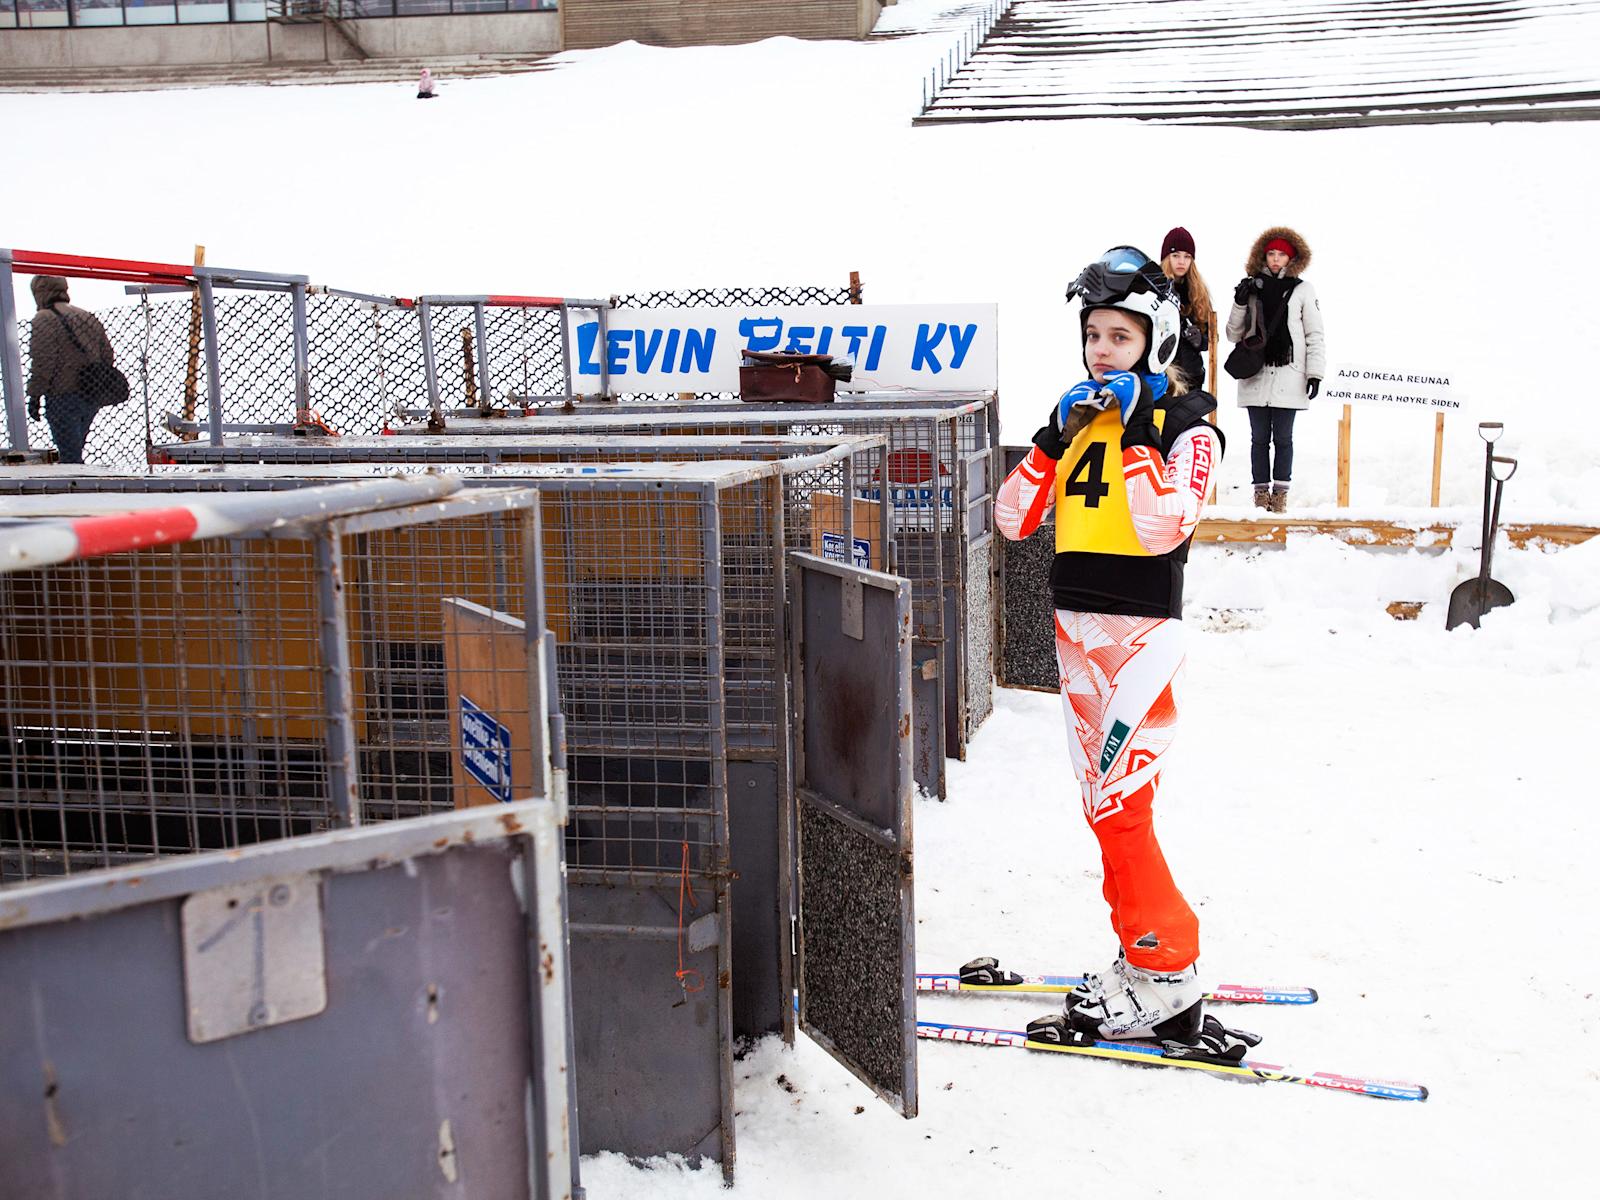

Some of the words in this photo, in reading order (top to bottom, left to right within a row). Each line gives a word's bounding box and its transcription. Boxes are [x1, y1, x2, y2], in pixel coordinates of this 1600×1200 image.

[577, 321, 717, 375] LEVIN
[911, 322, 978, 375] KY
[1337, 369, 1360, 379] AJO
[1363, 371, 1403, 383] OIKEAA
[1407, 375, 1450, 386] REUNAA
[1354, 392, 1379, 401] BARE
[1431, 398, 1460, 409] SIDEN
[1065, 441, 1110, 509] 4
[1190, 436, 1210, 499] HALTI
[1217, 991, 1313, 1002] SALOMON
[1309, 1077, 1423, 1099] SALOMON
